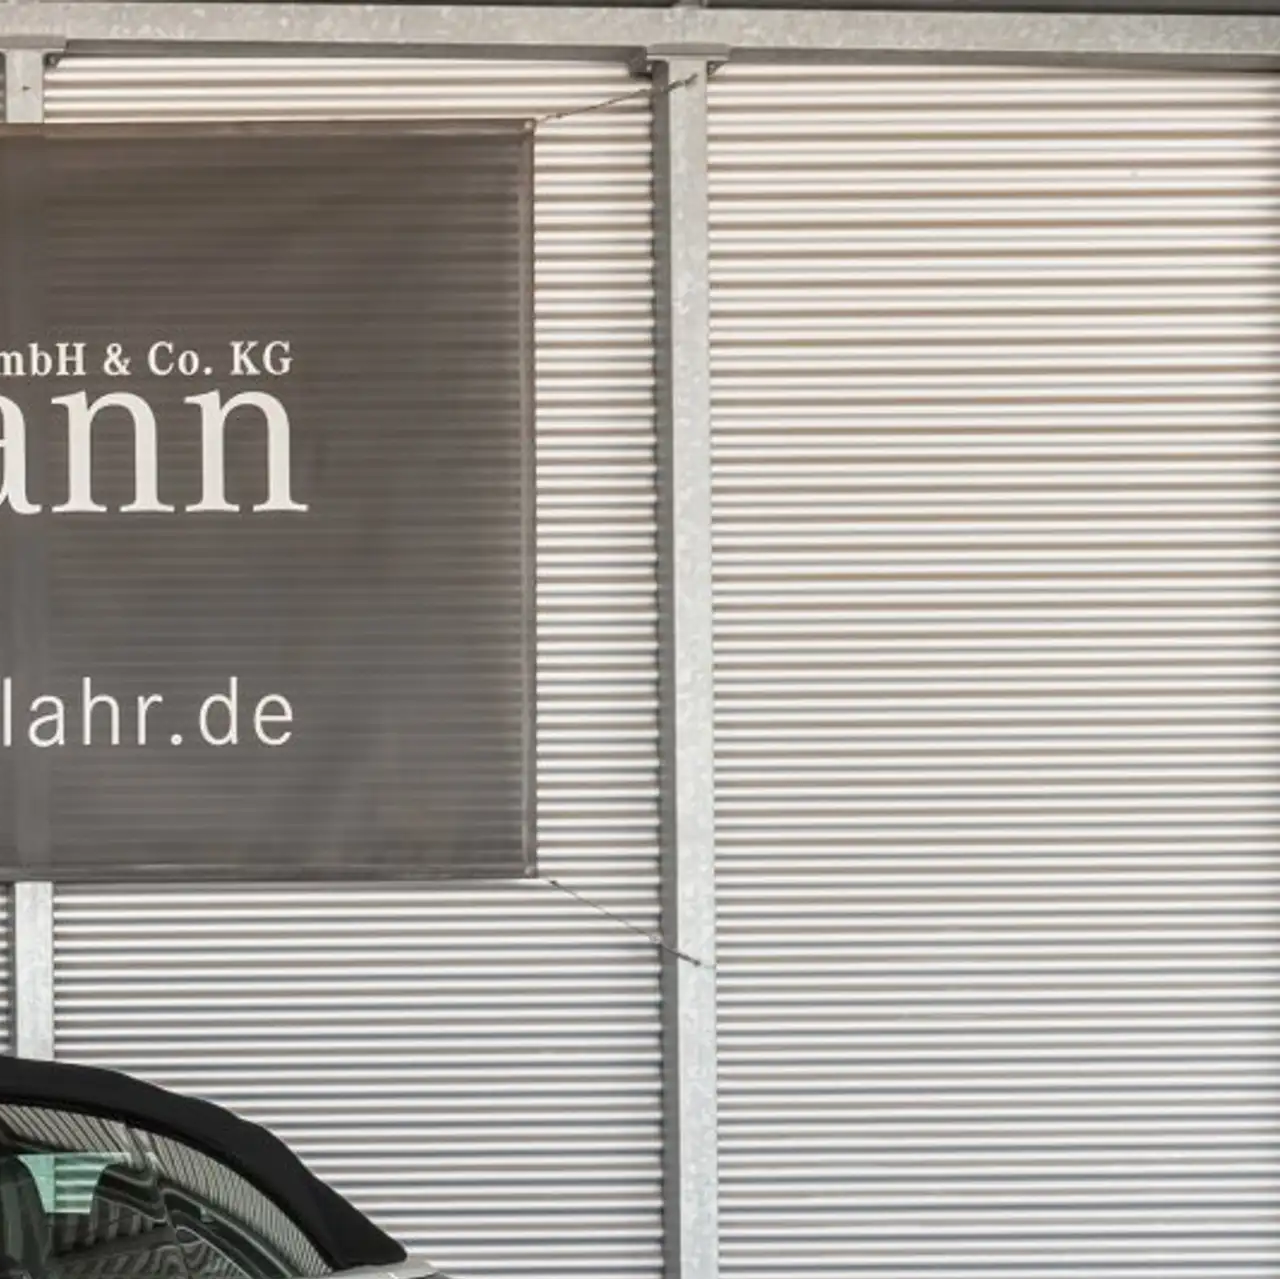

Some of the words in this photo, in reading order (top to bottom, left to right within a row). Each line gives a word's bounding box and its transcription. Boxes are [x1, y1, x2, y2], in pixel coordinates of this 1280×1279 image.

[103, 343, 131, 376] &
[148, 341, 212, 376] Co.
[231, 340, 292, 375] KG
